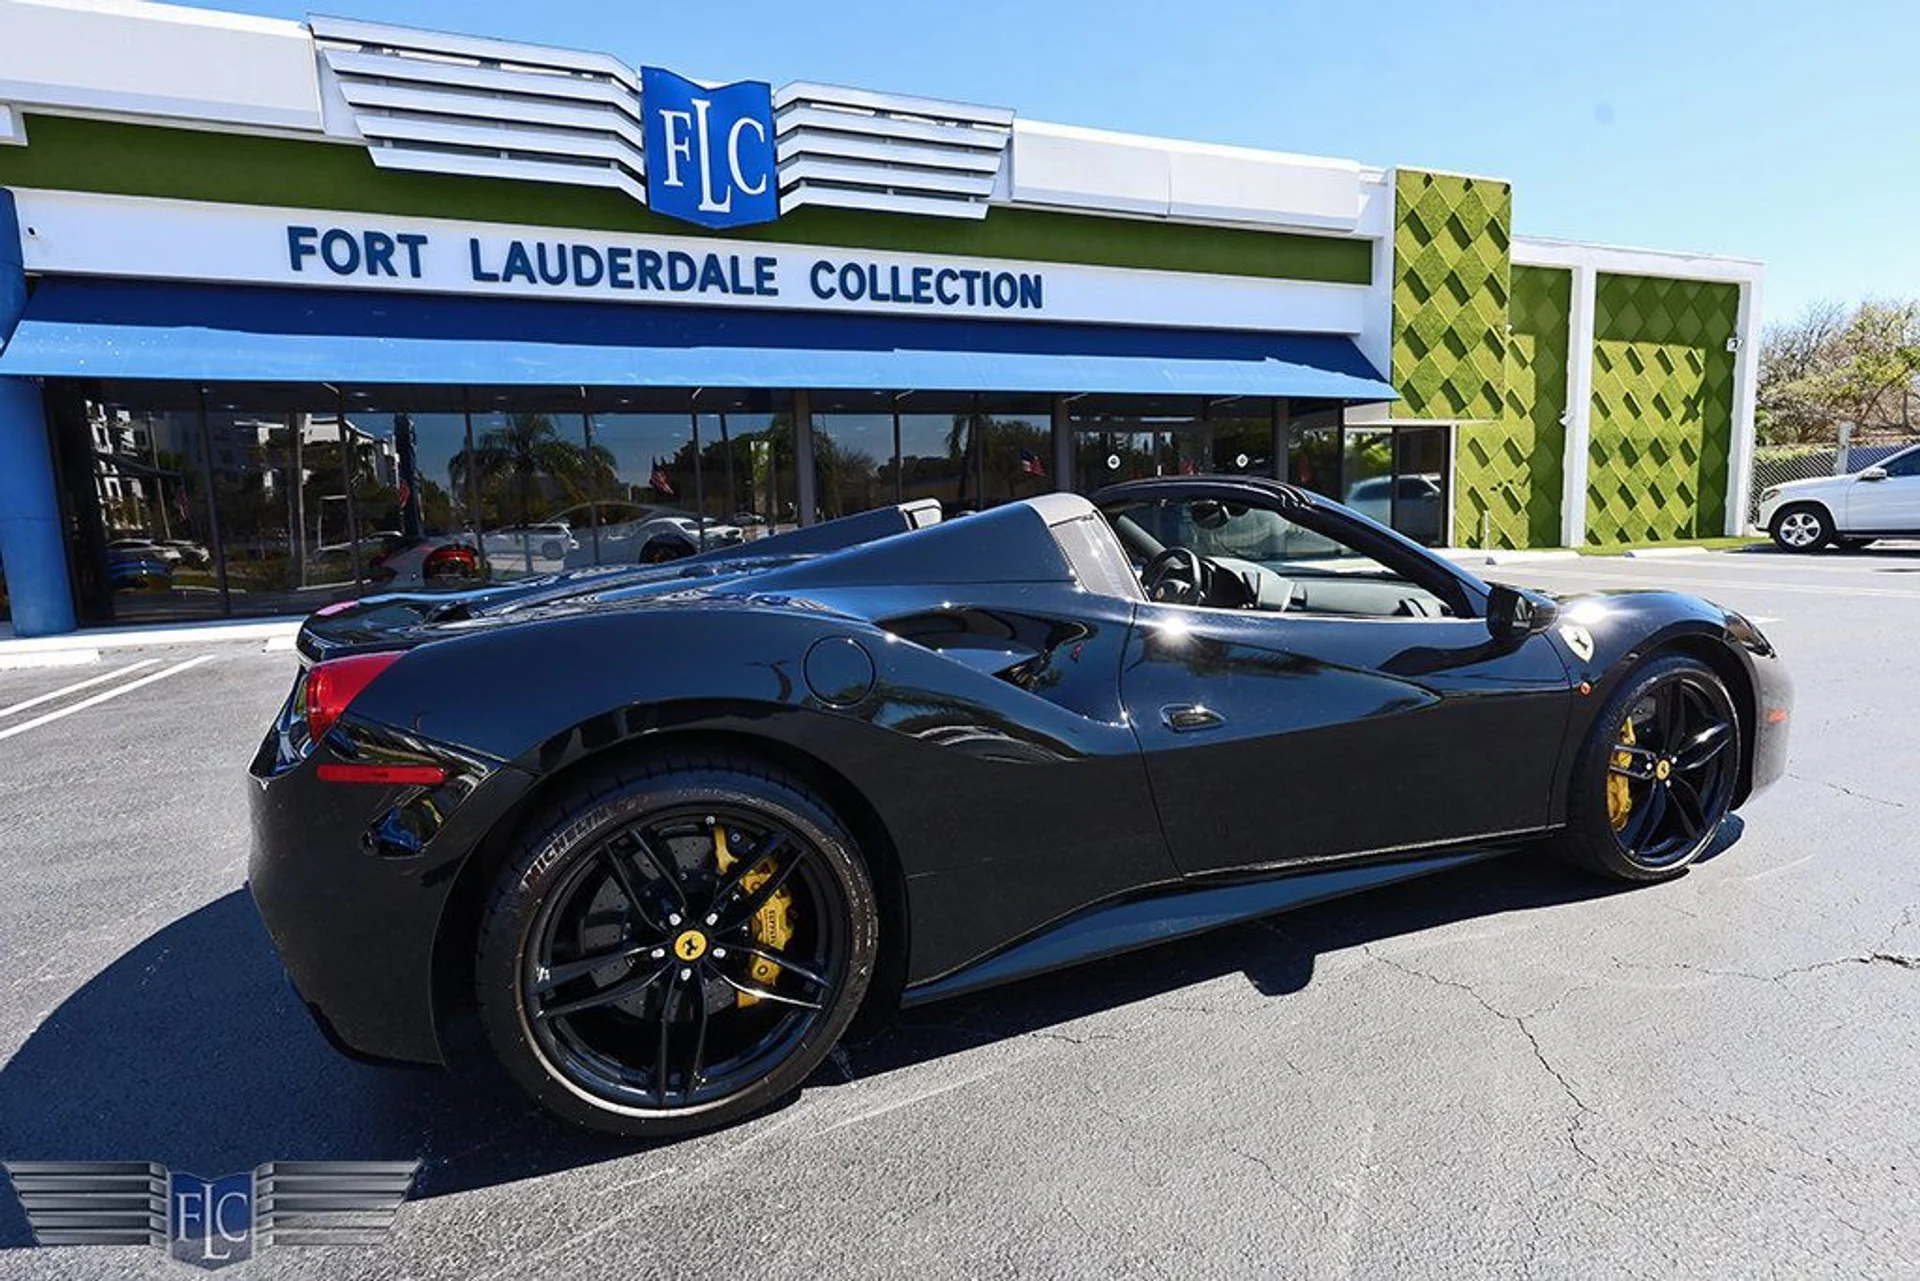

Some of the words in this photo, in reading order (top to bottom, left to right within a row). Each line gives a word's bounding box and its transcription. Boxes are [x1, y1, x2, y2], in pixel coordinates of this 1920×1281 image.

[658, 97, 767, 214] FLC
[287, 225, 428, 278] FORT
[469, 237, 779, 296] LAUDERDALE
[809, 260, 1043, 309] COLLECTION
